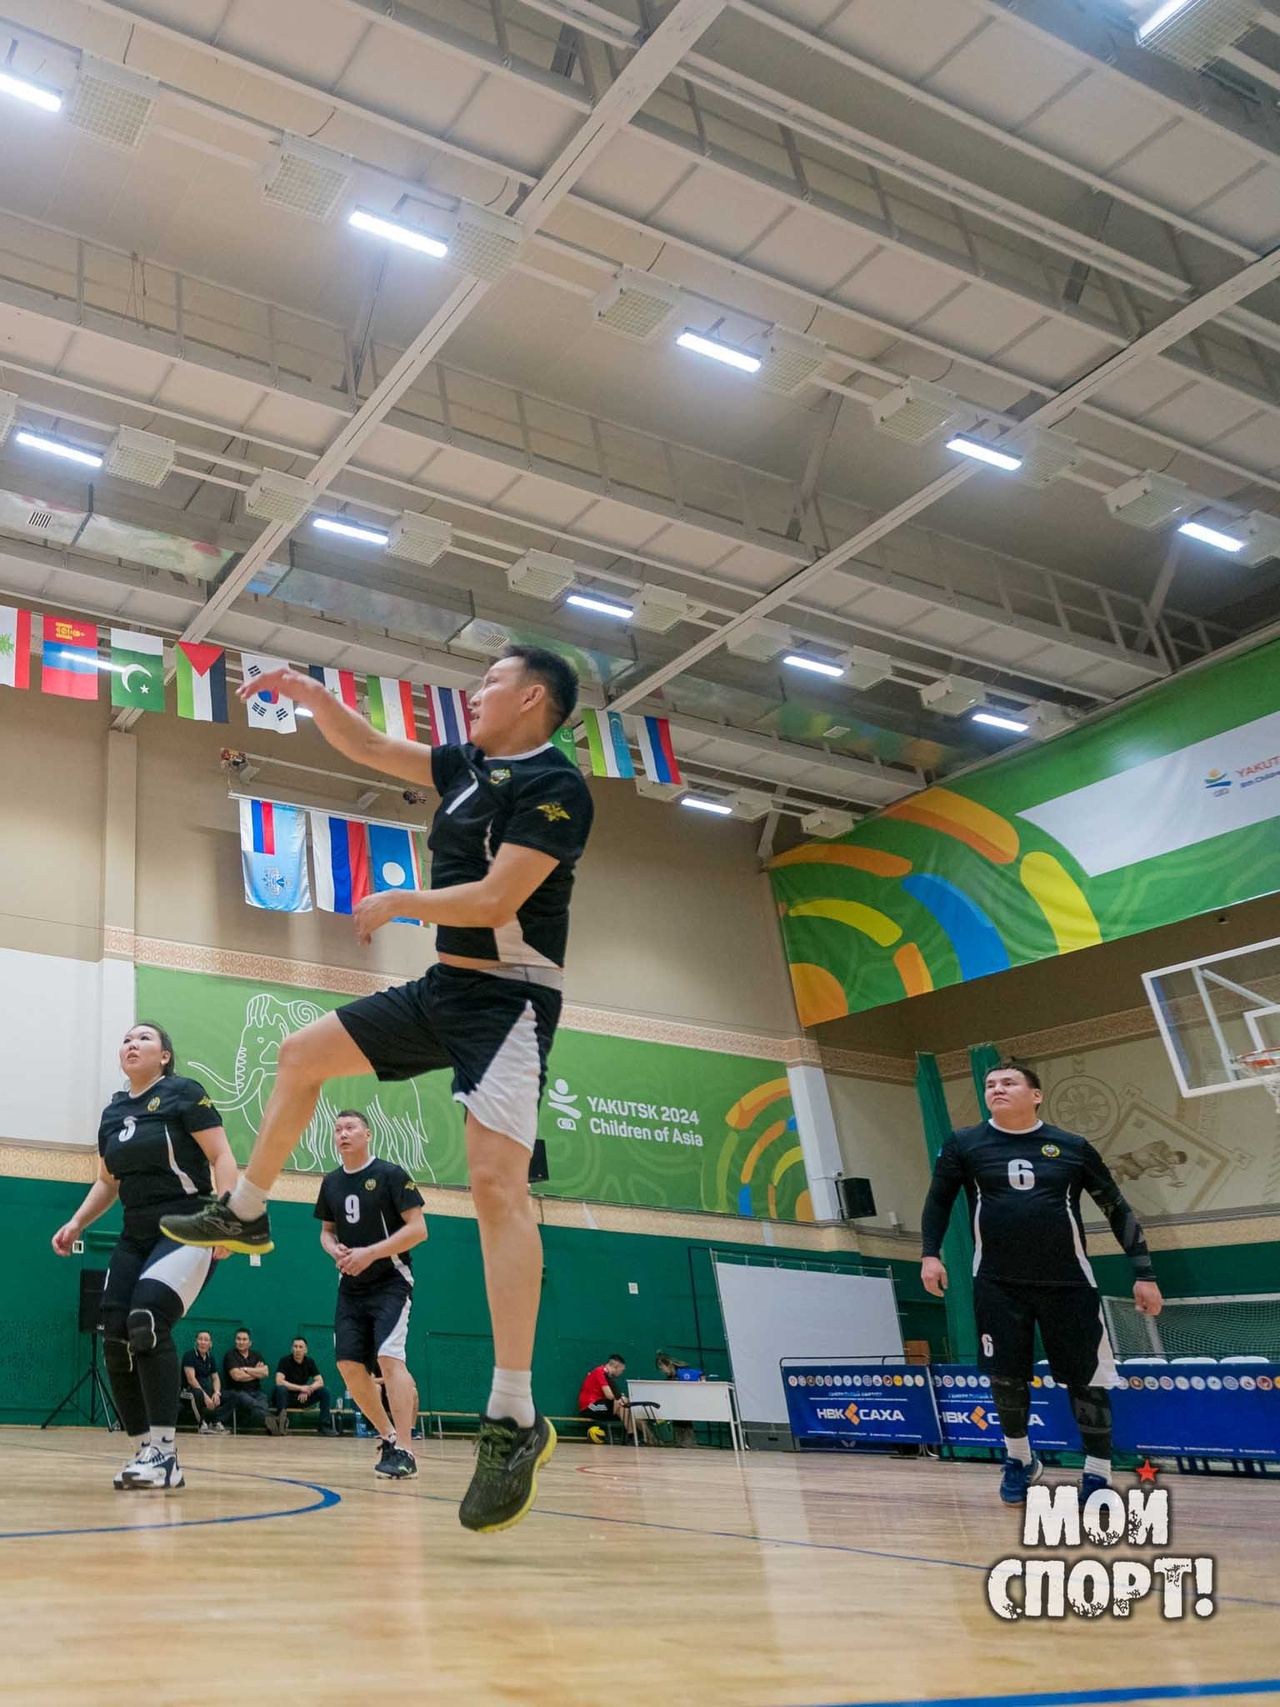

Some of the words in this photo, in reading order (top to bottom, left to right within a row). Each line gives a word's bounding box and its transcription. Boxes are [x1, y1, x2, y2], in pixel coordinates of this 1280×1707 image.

[586, 1095, 661, 1121] YAKUTSK
[660, 1106, 700, 1126] 2024
[589, 1116, 652, 1141] Children
[654, 1126, 670, 1143] of
[672, 1127, 704, 1147] Asia
[1007, 1158, 1035, 1190] 6
[344, 1194, 360, 1224] 9
[981, 1333, 995, 1358] 6
[816, 1408, 846, 1420] НВК
[859, 1409, 906, 1422] САХА
